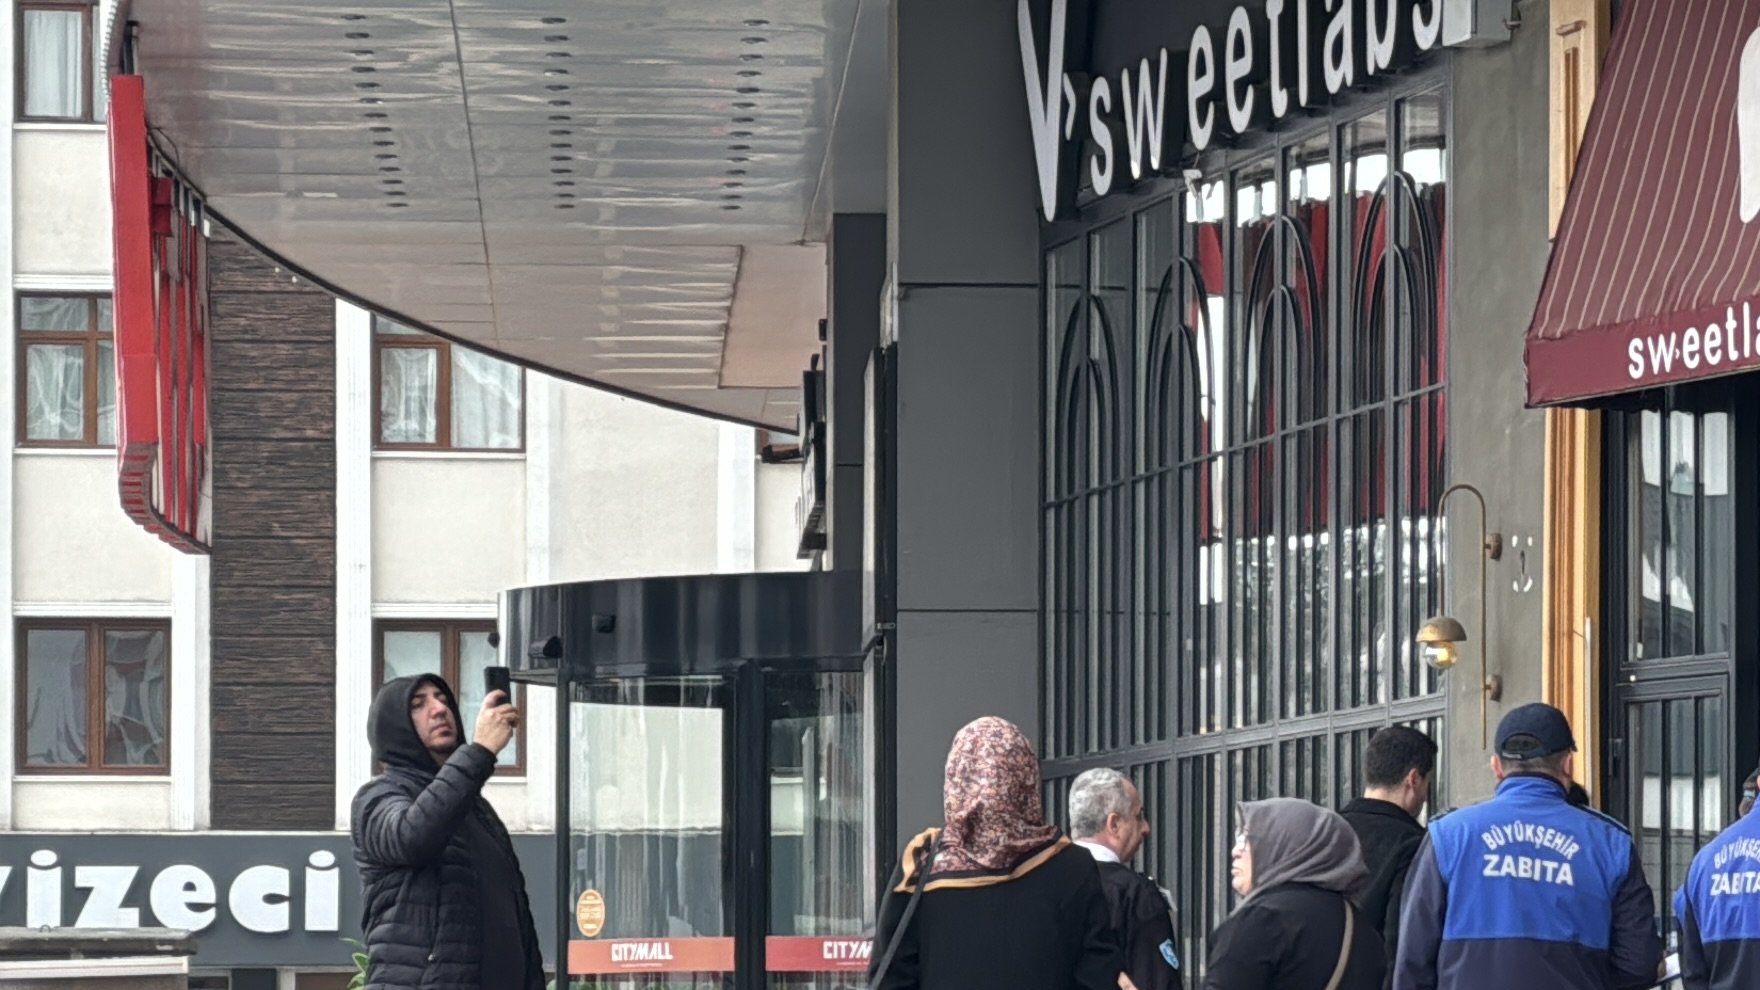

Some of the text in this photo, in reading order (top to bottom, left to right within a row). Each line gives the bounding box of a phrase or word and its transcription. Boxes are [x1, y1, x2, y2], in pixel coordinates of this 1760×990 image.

[1481, 819, 1580, 860] BÜYÜKŞEHİR
[1482, 853, 1574, 886] ZABITA
[0, 849, 340, 933] izeci
[611, 942, 674, 962] CITYMALL
[823, 941, 874, 959] CITYM
